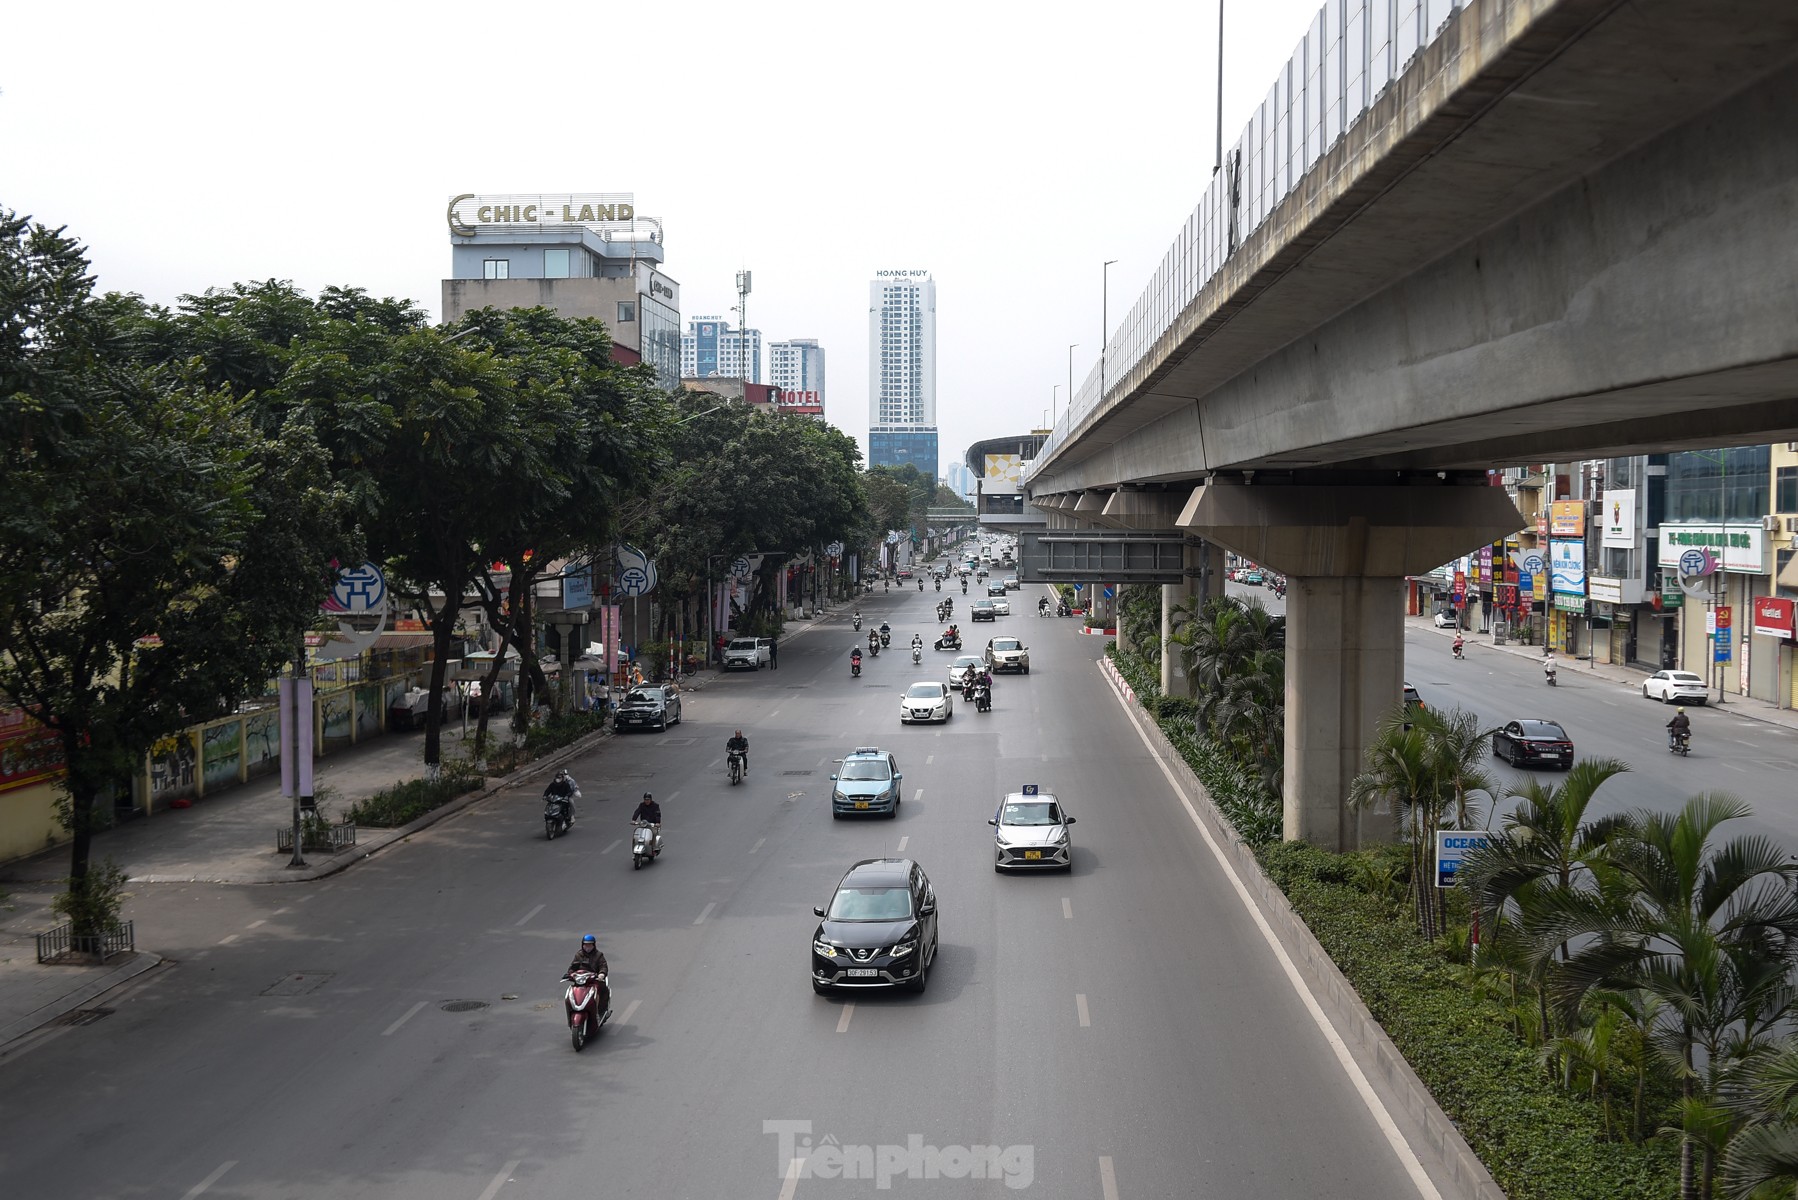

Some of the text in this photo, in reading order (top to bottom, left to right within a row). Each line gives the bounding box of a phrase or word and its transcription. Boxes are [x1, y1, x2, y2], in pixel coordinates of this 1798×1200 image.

[478, 204, 537, 222] CHIC
[562, 203, 634, 222] LAND
[779, 391, 821, 404] HOTEL
